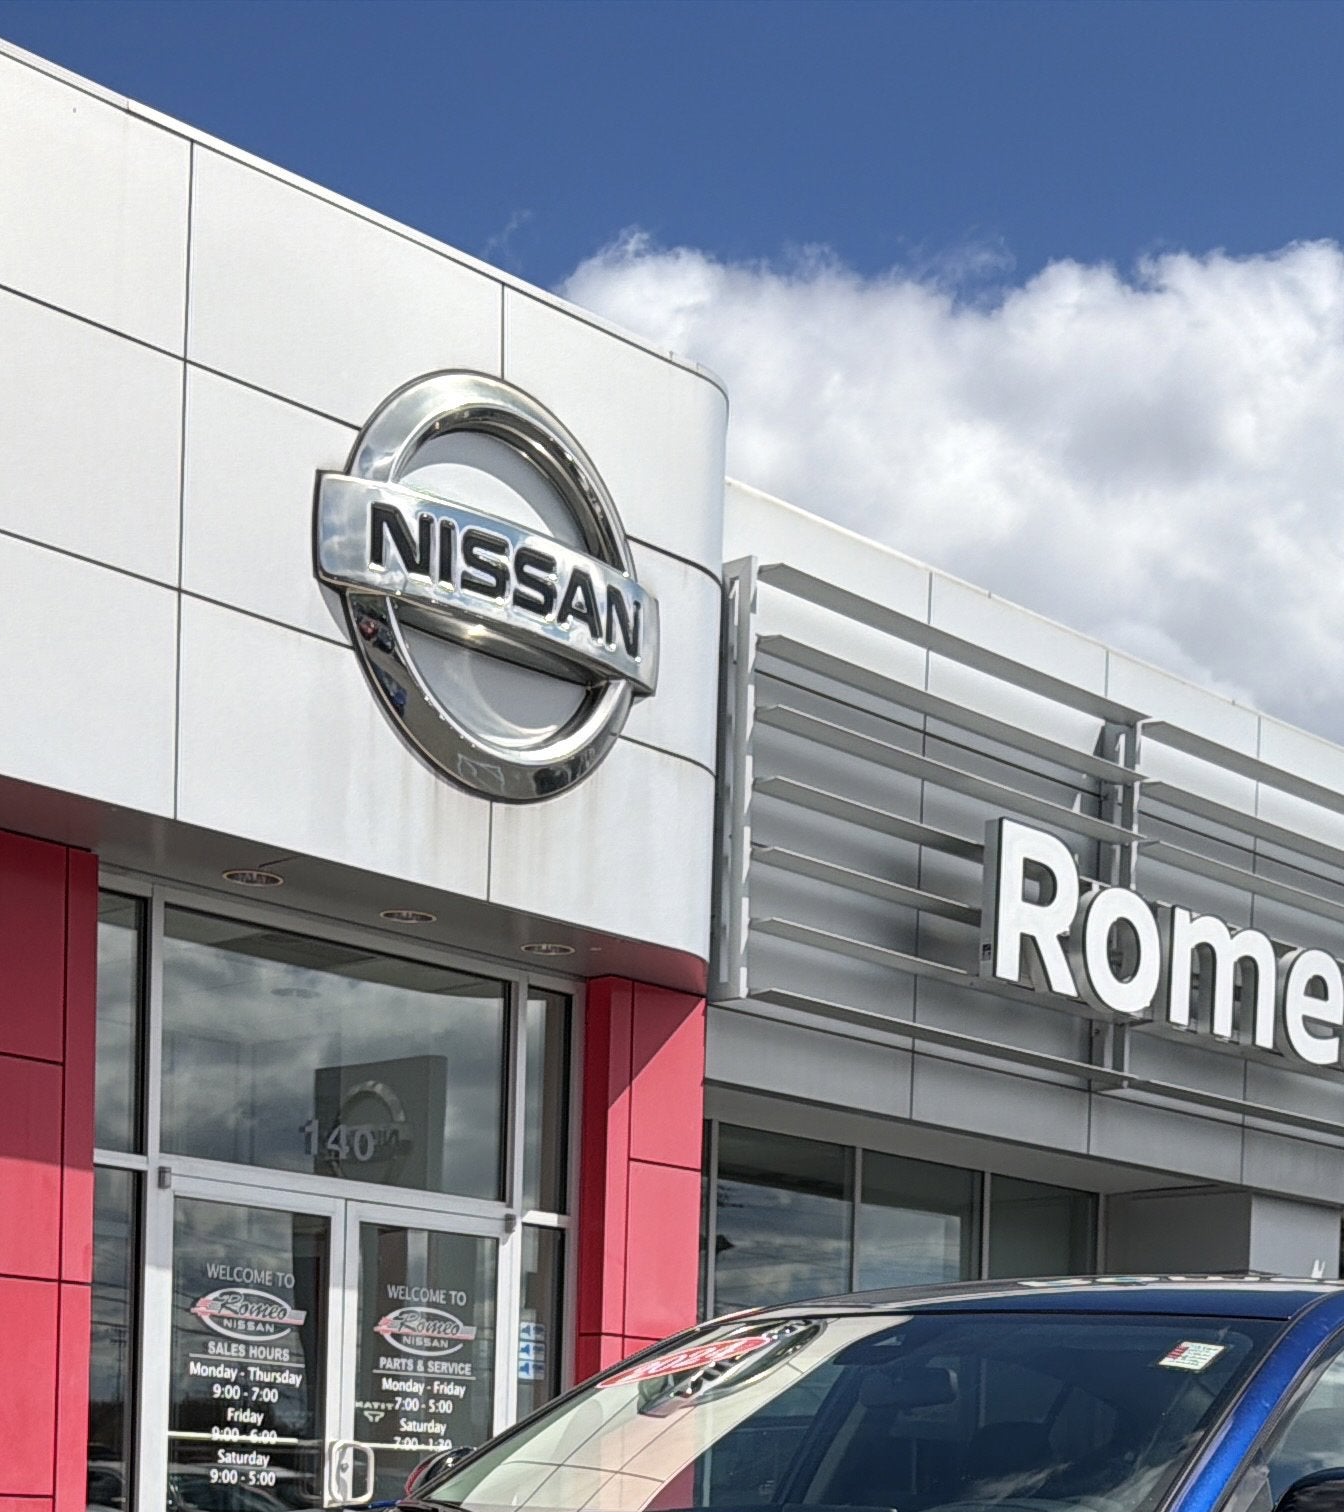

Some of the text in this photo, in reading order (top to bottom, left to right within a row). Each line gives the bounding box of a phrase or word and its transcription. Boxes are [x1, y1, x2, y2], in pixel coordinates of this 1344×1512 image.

[367, 500, 644, 663] NISSAN
[304, 1118, 375, 1162] 140
[206, 1263, 295, 1289] WELCOME TO
[387, 1284, 467, 1306] WELCOME TO
[218, 1291, 288, 1320] Romeo
[223, 1319, 275, 1333] NISSAN
[397, 1310, 460, 1336] Romeo
[207, 1340, 290, 1361] SALES HOURS
[402, 1335, 449, 1348] NISSAN
[189, 1361, 238, 1381] Monday
[247, 1366, 303, 1388] Thursday
[379, 1356, 472, 1376] PARTS & SERVICE
[212, 1383, 241, 1399] 9:00
[251, 1387, 279, 1402] 7:00
[381, 1377, 425, 1395] Monday
[433, 1381, 466, 1399] Friday
[394, 1396, 419, 1411] 7:00
[428, 1399, 453, 1414] 5:00
[226, 1407, 264, 1426] Friday
[399, 1418, 447, 1436] Saturday
[217, 1449, 271, 1469] Saturday
[209, 1469, 238, 1484] 9:00
[248, 1470, 276, 1486] 5:00
